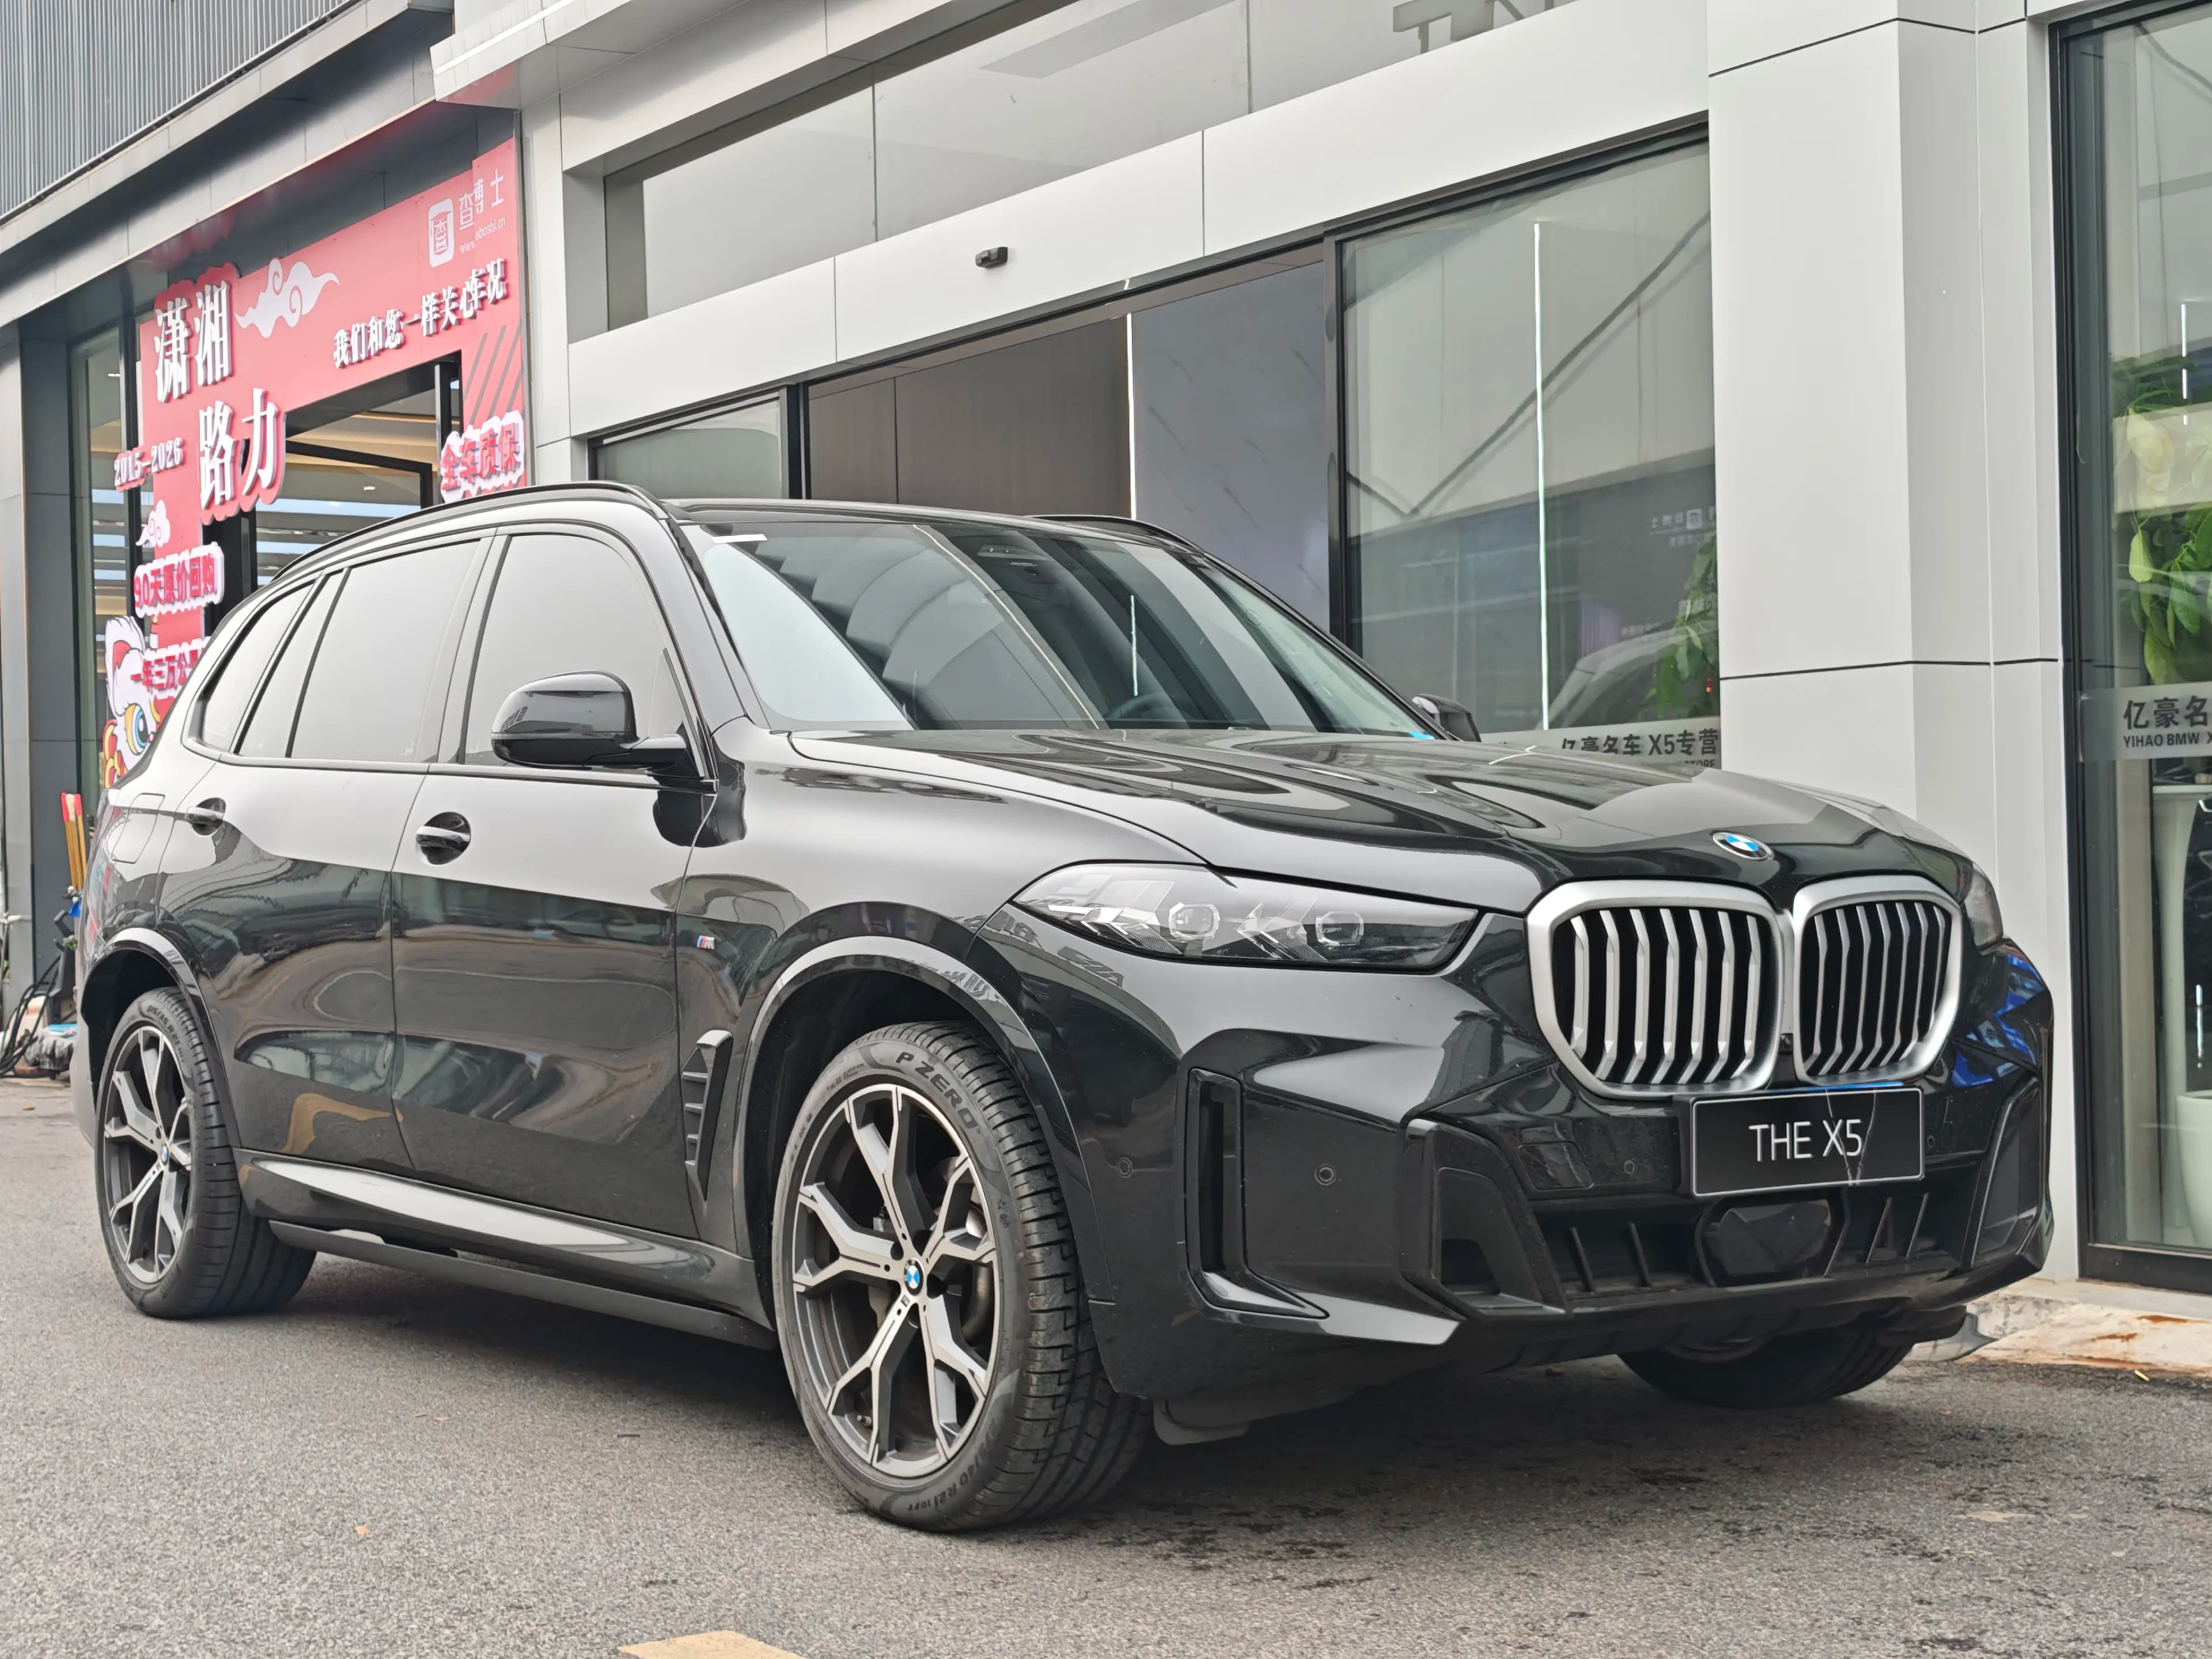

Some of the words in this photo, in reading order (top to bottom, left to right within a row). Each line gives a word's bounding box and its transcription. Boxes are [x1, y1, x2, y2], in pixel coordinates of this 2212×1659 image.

[154, 280, 232, 403] 潇湘
[333, 257, 508, 369] 我们和您一样关心车况
[199, 387, 279, 510] 路力
[440, 422, 519, 491] 全车质保
[134, 552, 215, 608] 90天原价回购
[2123, 695, 2207, 730] 亿豪名
[2123, 733, 2163, 748] YIHAO
[2166, 732, 2200, 746] BMW
[895, 1051, 915, 1064] P
[915, 1060, 978, 1130] ZERO
[1749, 1121, 1813, 1162] THE
[1823, 1119, 1862, 1157] X5
